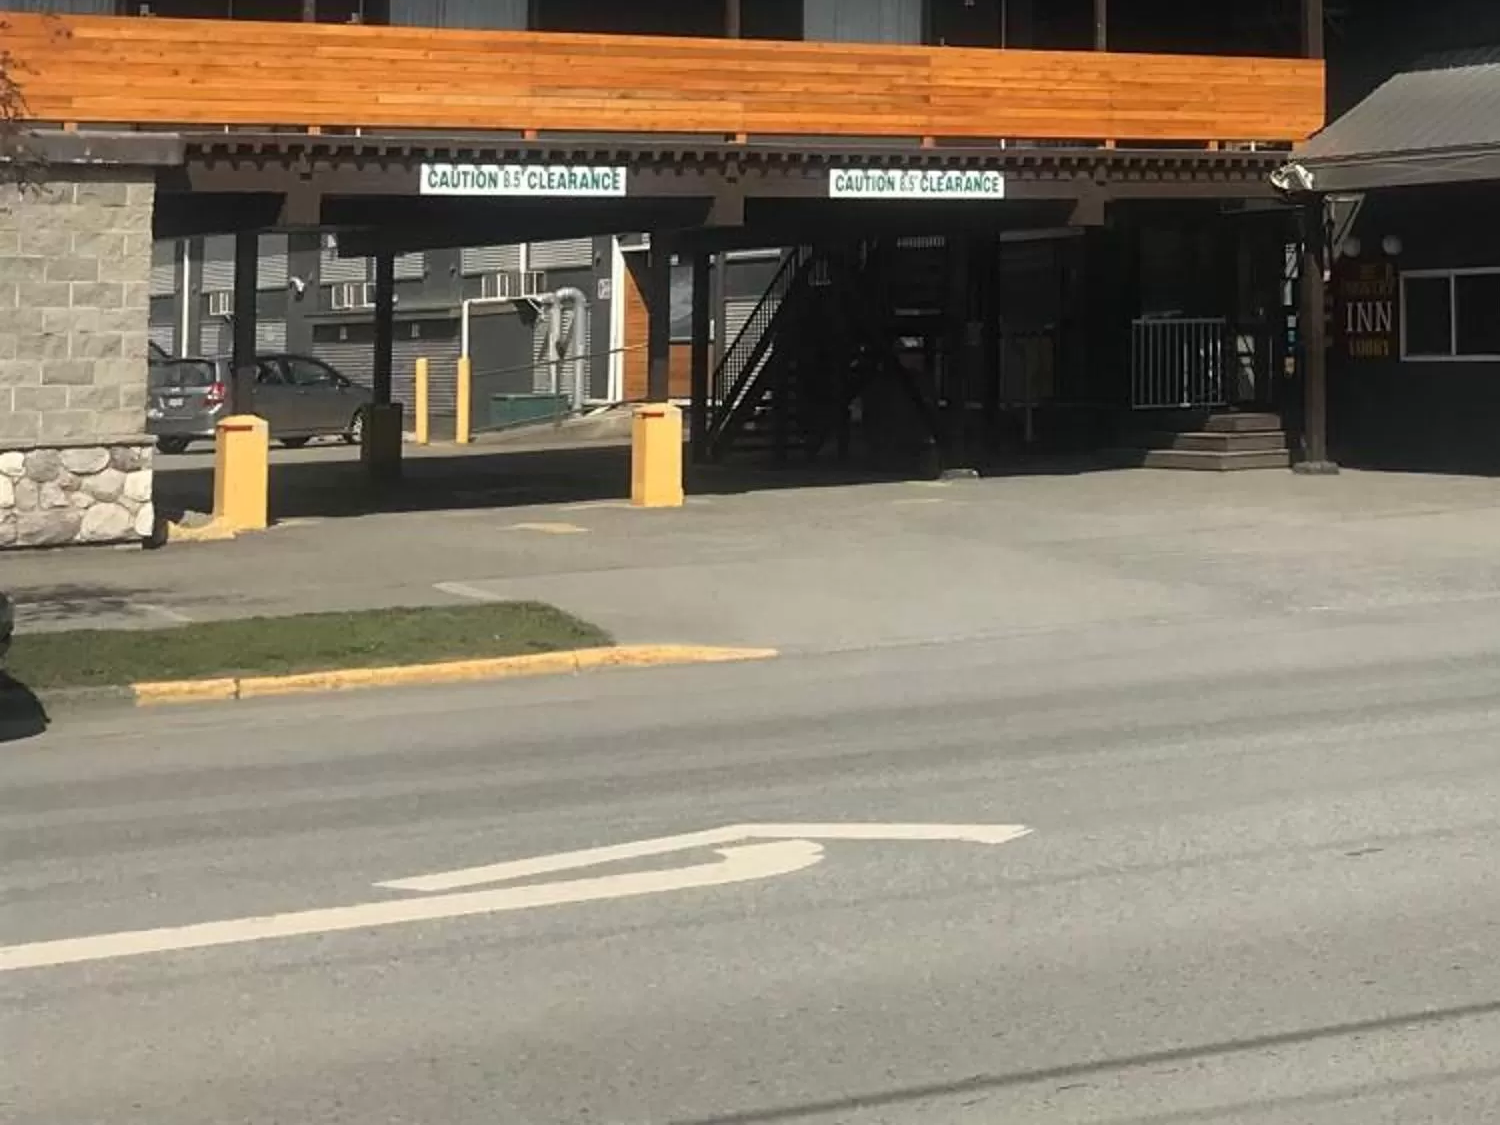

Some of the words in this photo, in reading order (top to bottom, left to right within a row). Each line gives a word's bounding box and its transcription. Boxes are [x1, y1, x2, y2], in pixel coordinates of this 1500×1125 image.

[427, 170, 499, 188] CAUTION
[527, 170, 621, 191] CLEARANCE
[834, 174, 895, 192] CAUTION
[919, 174, 999, 193] CLEARANCE
[1345, 300, 1393, 333] INN
